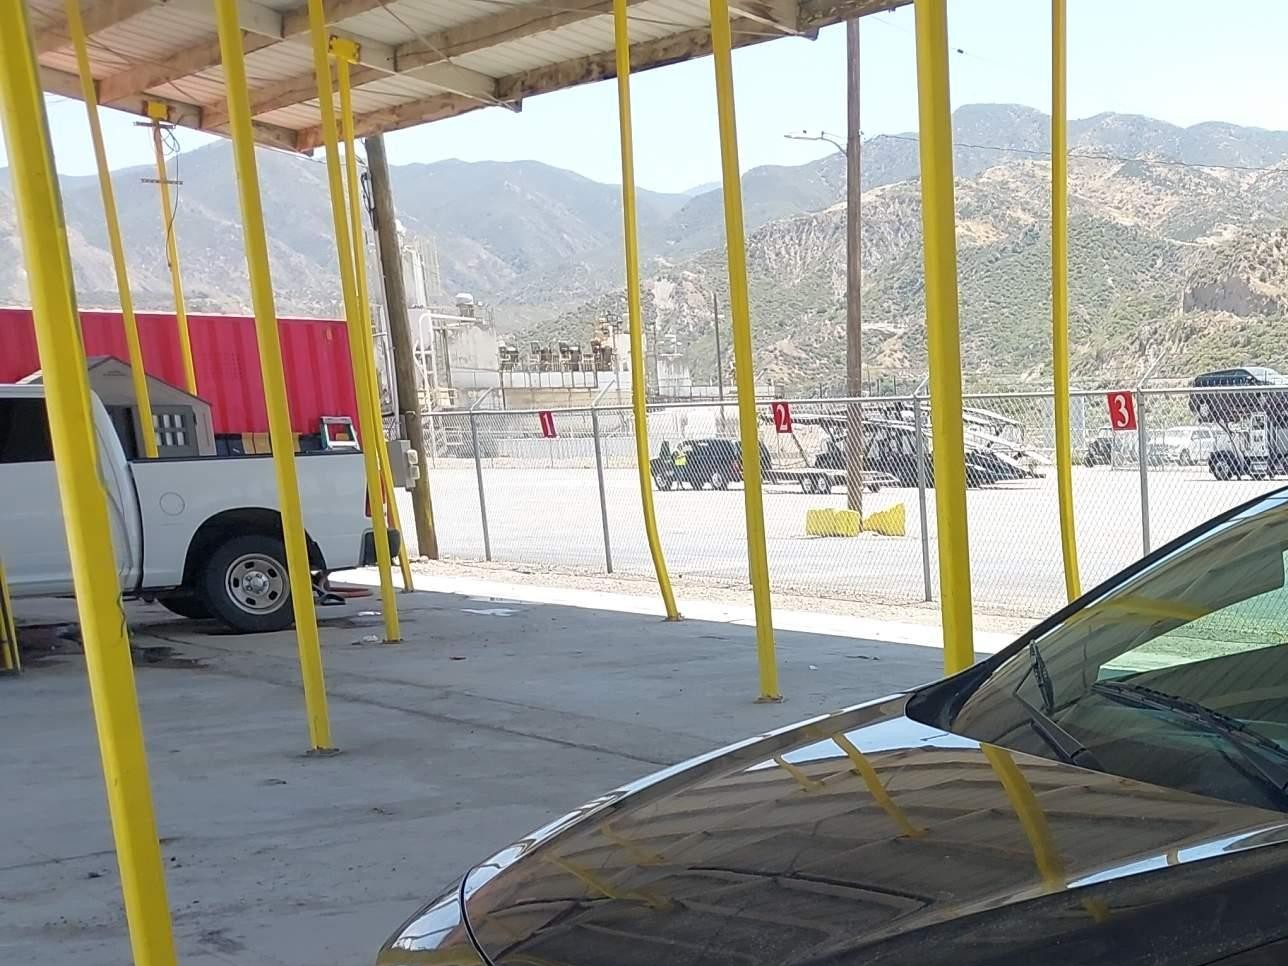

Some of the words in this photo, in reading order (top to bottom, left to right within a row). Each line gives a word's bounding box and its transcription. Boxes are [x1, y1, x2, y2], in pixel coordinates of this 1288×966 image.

[543, 411, 553, 435] 1
[776, 404, 788, 430] 2
[1114, 395, 1129, 427] 3
